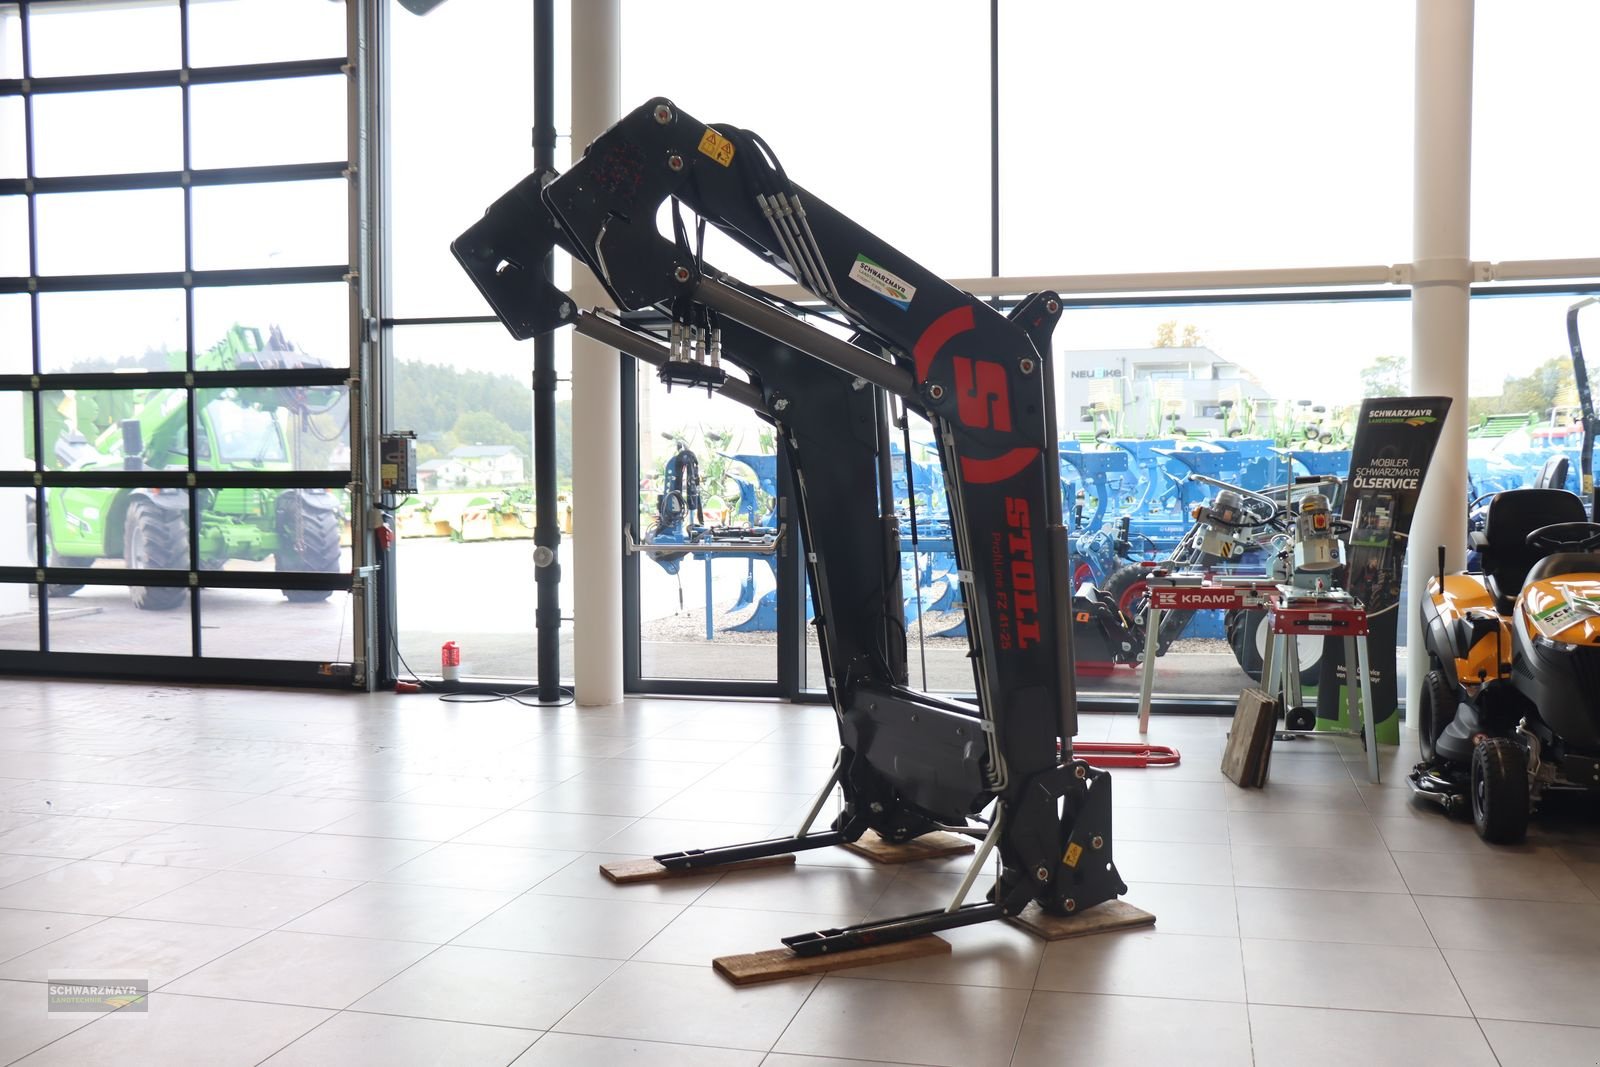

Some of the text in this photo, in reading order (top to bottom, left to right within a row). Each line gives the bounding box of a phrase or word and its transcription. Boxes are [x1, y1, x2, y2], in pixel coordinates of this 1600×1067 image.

[860, 262, 906, 294] SCHWARZMAYR
[1368, 409, 1433, 418] SCHWARZMAYR
[1370, 458, 1409, 467] MOBILER
[1355, 467, 1421, 477] SCHWARZMAYR
[1353, 475, 1418, 489] ÖLSERVICE
[1005, 496, 1041, 649] STOLL
[996, 591, 1009, 609] FZ
[1181, 595, 1236, 603] KRAMP
